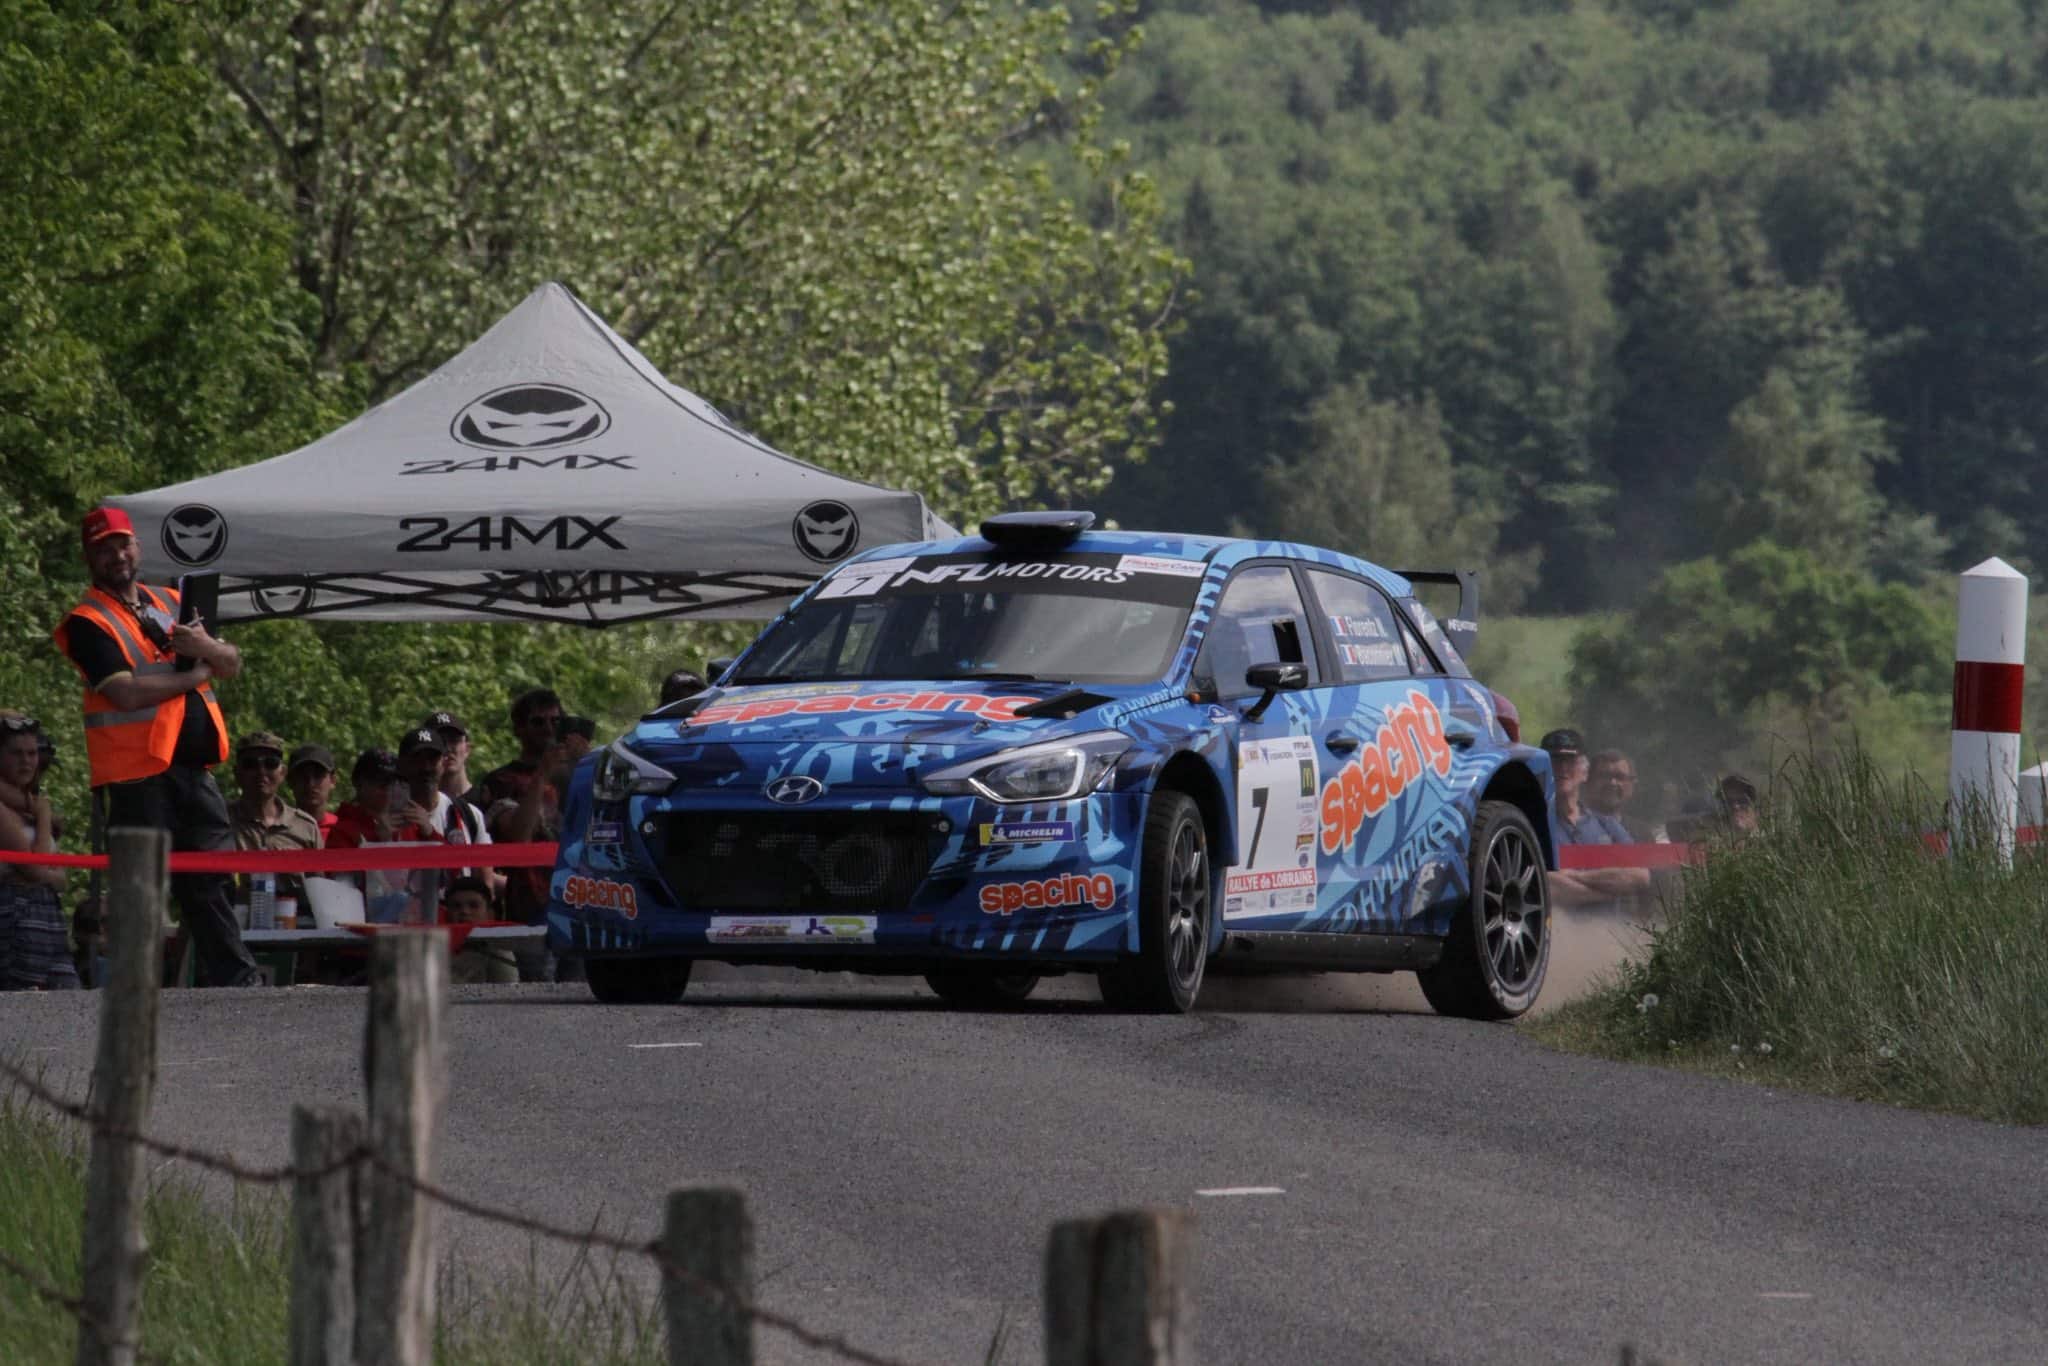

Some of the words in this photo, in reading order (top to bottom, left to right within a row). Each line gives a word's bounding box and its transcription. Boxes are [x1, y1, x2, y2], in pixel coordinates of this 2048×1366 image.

[401, 454, 638, 475] 24MX
[396, 516, 629, 552] 24MX
[892, 563, 998, 588] NFL
[996, 563, 1136, 584] MOTORS
[689, 691, 1044, 726] spacing
[1319, 689, 1451, 857] spacing
[1008, 827, 1064, 838] MICHELIN
[1246, 787, 1269, 869] 7
[563, 876, 638, 918] spacing
[980, 873, 1115, 915] spacing
[1229, 876, 1258, 892] RALLYE
[1272, 869, 1314, 888] LORRAINE
